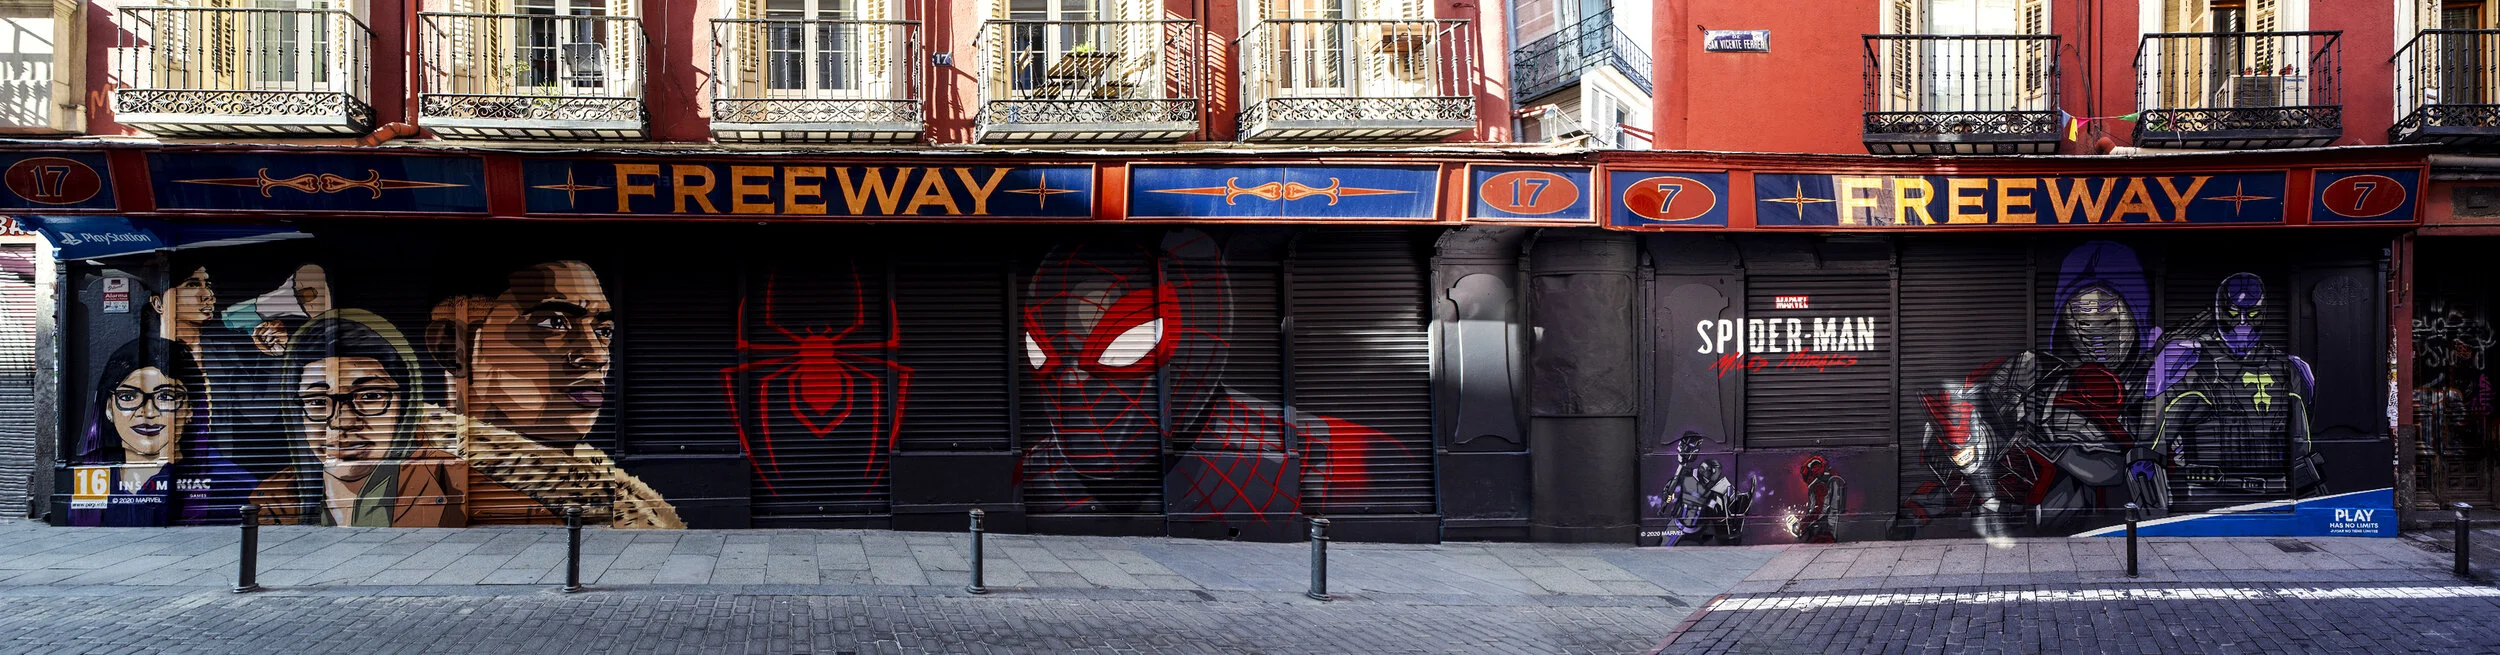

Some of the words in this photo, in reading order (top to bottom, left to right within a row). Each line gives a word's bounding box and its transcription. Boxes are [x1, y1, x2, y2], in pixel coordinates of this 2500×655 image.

[935, 53, 949, 65] 17
[1720, 40, 1742, 50] VICENTE
[1743, 40, 1764, 50] FERRER
[30, 165, 71, 197] 17
[612, 163, 1015, 215] FREEWAY
[1509, 178, 1550, 208] 17
[1658, 184, 1682, 214] 7
[1838, 175, 2214, 225] FREEWAY
[2352, 182, 2378, 211] 7
[80, 232, 151, 245] PlayStation
[1775, 296, 1808, 309] MARVEL
[1696, 317, 1875, 358] SPIDER-MAN
[77, 469, 108, 495] 16
[2335, 509, 2374, 522] PLAY
